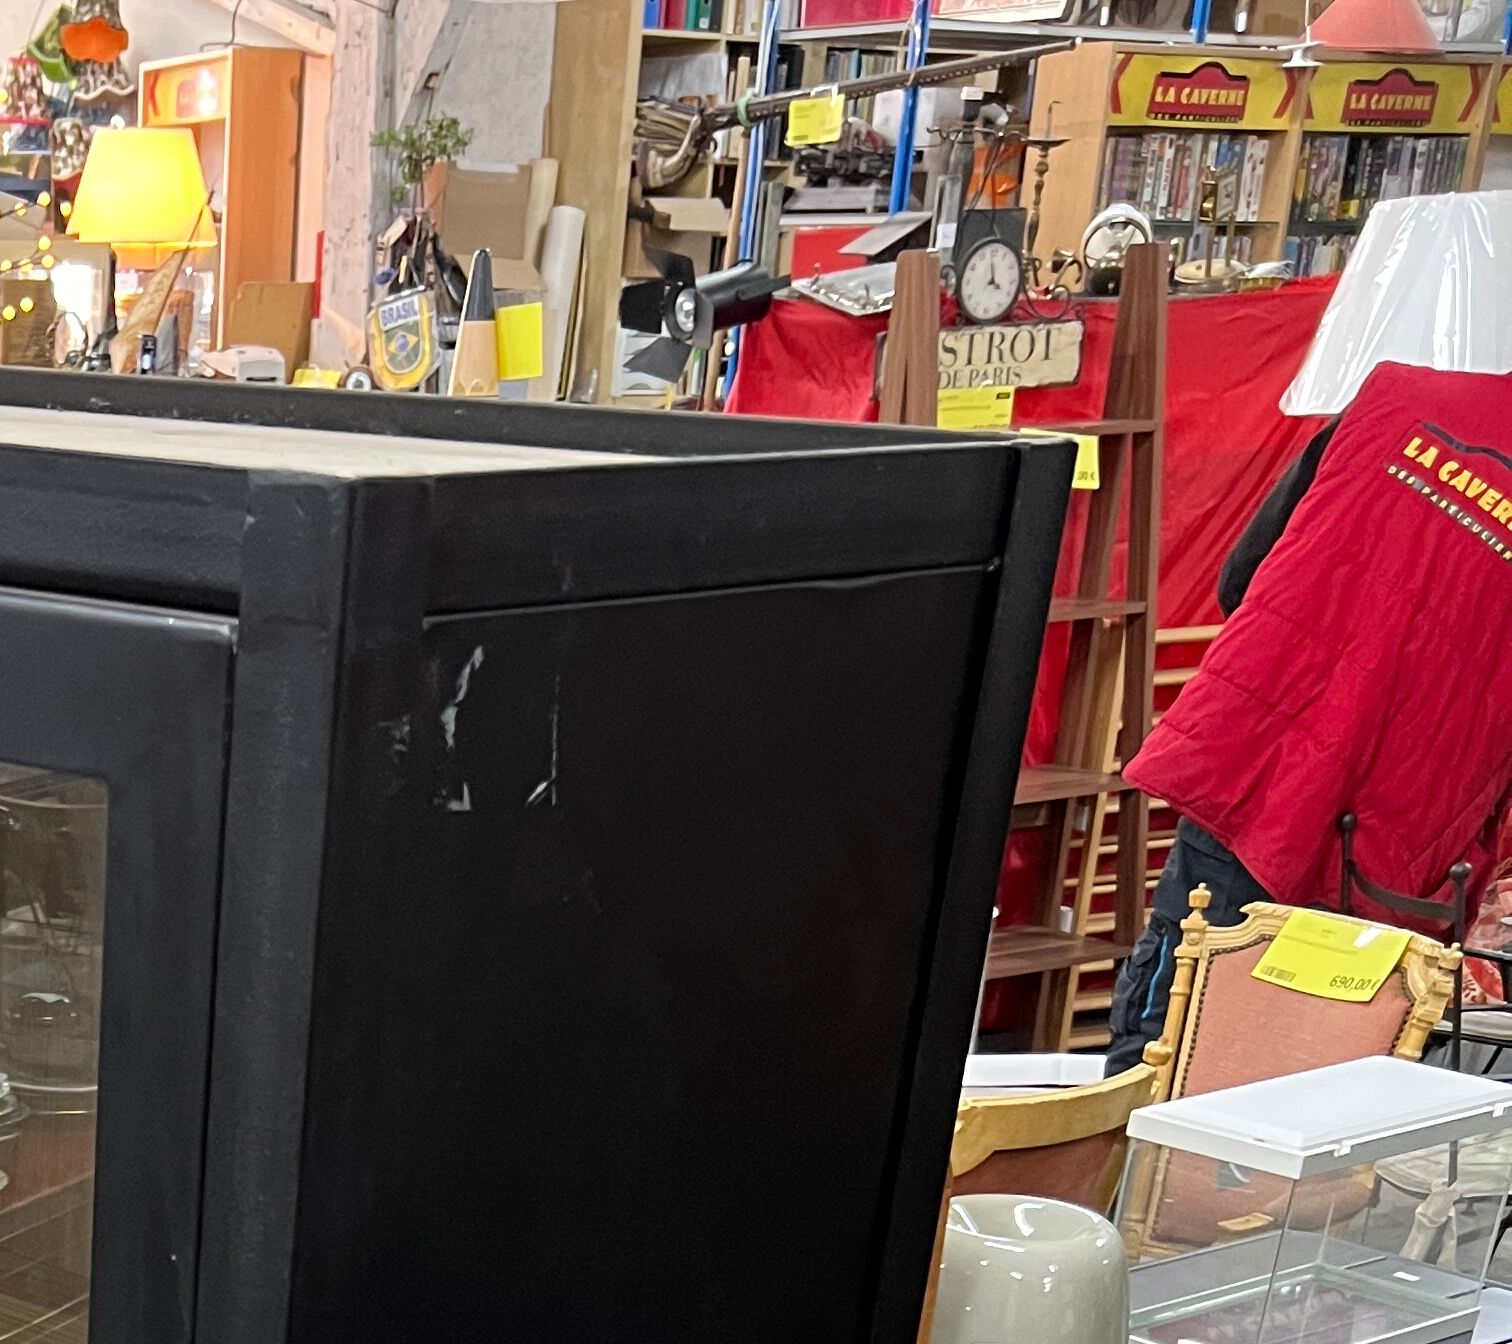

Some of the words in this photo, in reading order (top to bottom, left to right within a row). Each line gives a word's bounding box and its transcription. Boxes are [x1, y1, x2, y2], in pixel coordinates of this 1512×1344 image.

[1155, 86, 1176, 103] LA
[1180, 87, 1245, 106] CAVERNE
[1349, 93, 1367, 110] LA
[1370, 93, 1433, 111] CAVERNE
[381, 299, 418, 328] BRASIL
[940, 328, 1061, 368] STROT
[937, 369, 963, 389] DE
[968, 365, 1022, 389] PARIS
[1387, 465, 1417, 485] DES
[1403, 436, 1439, 469] LA
[1438, 460, 1512, 532] CAVER
[1329, 975, 1372, 991] 690,00
